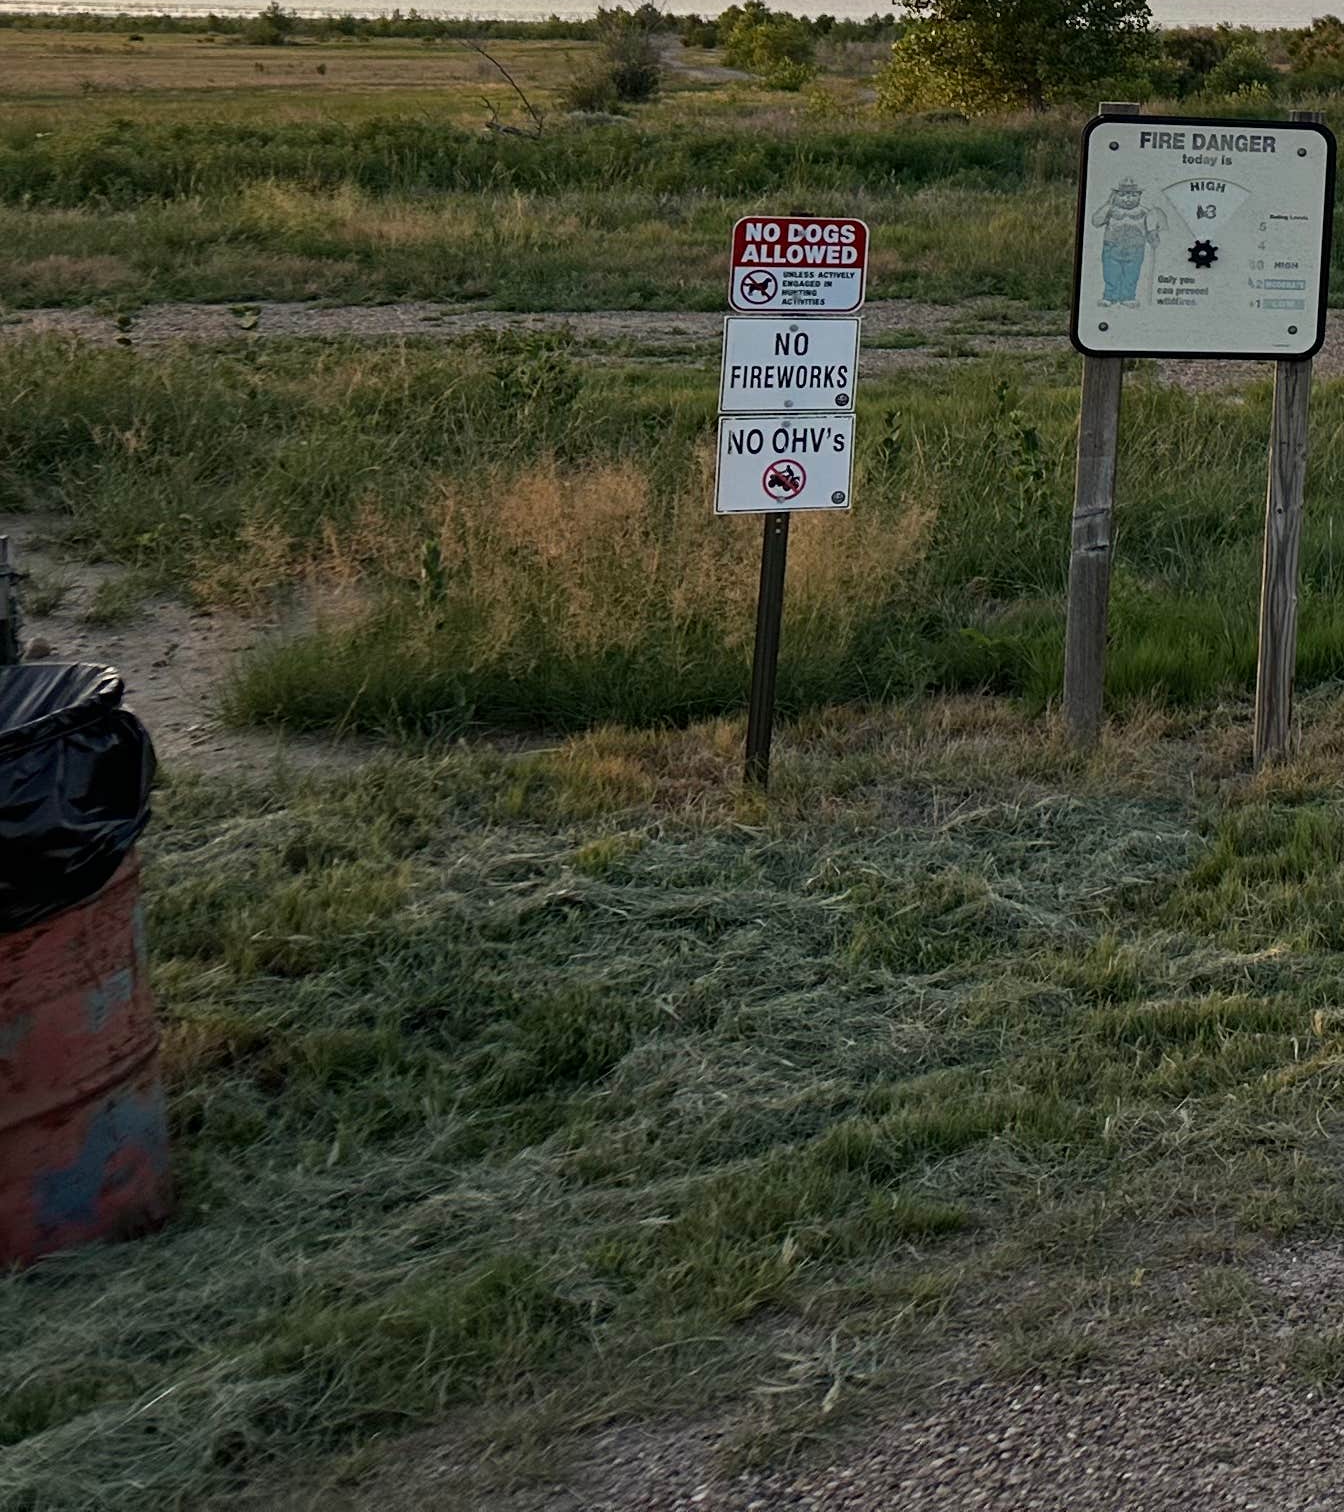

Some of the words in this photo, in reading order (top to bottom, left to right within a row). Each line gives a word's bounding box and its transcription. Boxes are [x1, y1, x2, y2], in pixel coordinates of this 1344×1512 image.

[1140, 131, 1185, 149] FIRE
[1192, 133, 1276, 153] DANGER
[1182, 153, 1217, 166] today
[1221, 155, 1232, 166] is
[1190, 181, 1226, 193] HIGH
[745, 223, 781, 242] NO
[787, 224, 856, 244] DOGS
[741, 244, 858, 265] ALLOWED
[782, 280, 821, 288] ENGAGED
[783, 271, 815, 279] UNLESS
[817, 271, 856, 280] ACTIVELY
[781, 298, 826, 306] ACTIVITIES
[774, 332, 810, 356] NO
[730, 365, 849, 389] FIREWORKS
[727, 428, 764, 455] NO
[772, 427, 846, 454] OHV's
